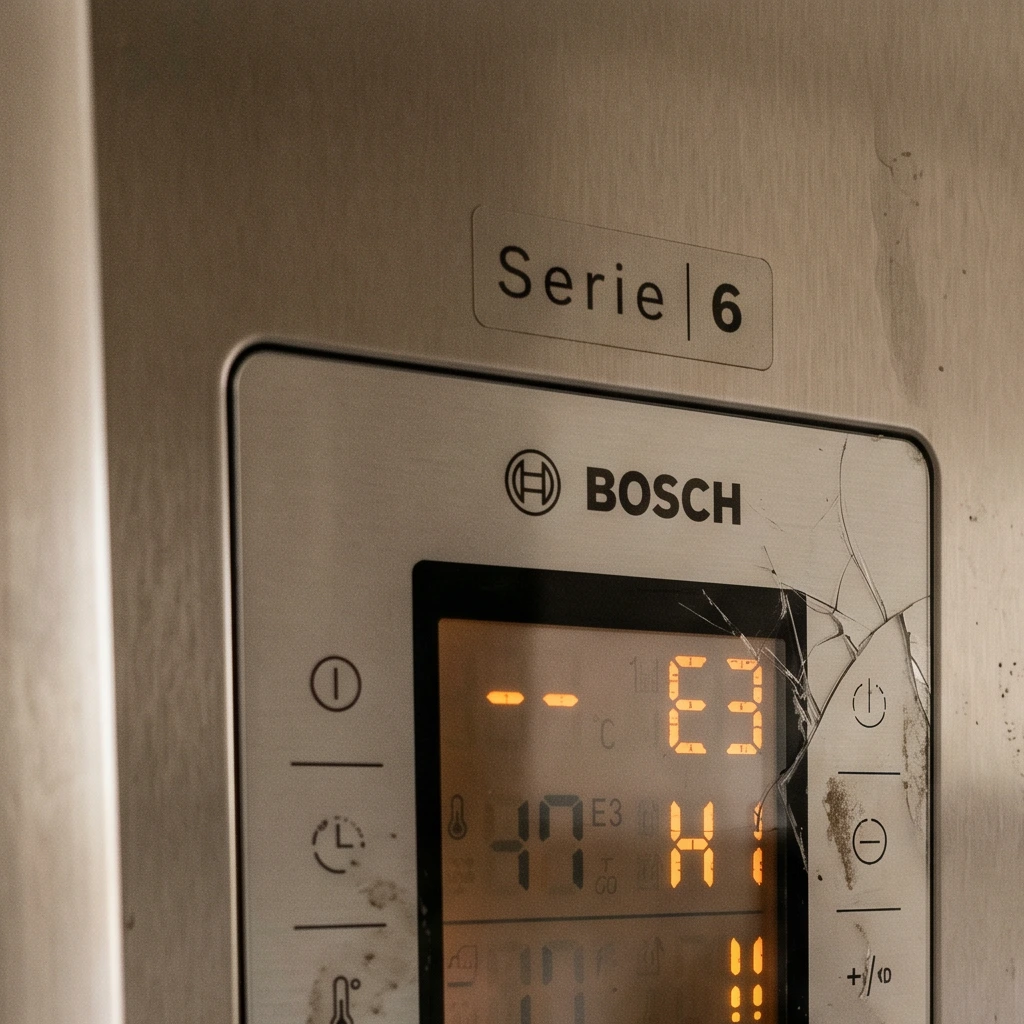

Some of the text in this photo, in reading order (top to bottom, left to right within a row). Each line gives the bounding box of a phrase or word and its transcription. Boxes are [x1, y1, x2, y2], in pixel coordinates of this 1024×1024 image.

[498, 245, 742, 333] Serie 6
[586, 466, 742, 526] BOSCH
[668, 654, 763, 756] E3
[591, 797, 623, 828] E3
